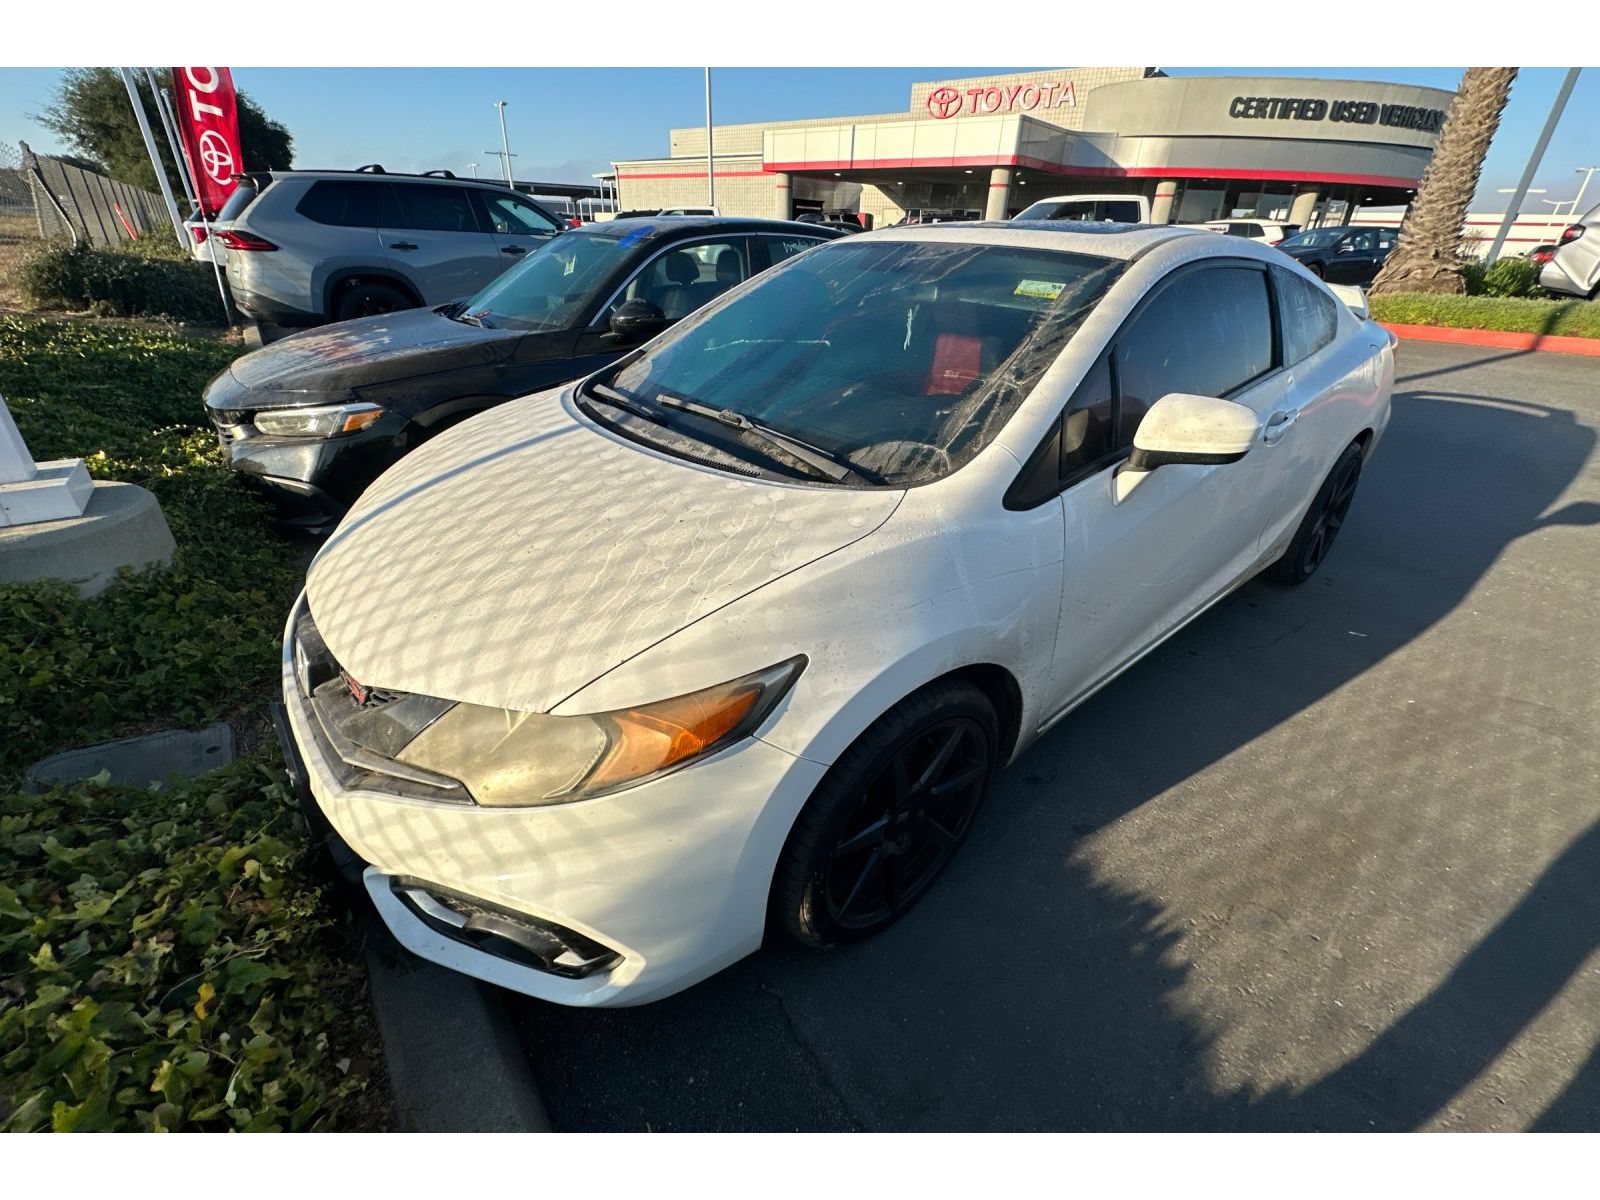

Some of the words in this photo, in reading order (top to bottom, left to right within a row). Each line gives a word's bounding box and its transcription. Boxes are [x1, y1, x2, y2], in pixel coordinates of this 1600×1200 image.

[967, 81, 1076, 113] TOYOTA
[1229, 96, 1328, 121] CERTIFIED
[1329, 100, 1380, 125] USED
